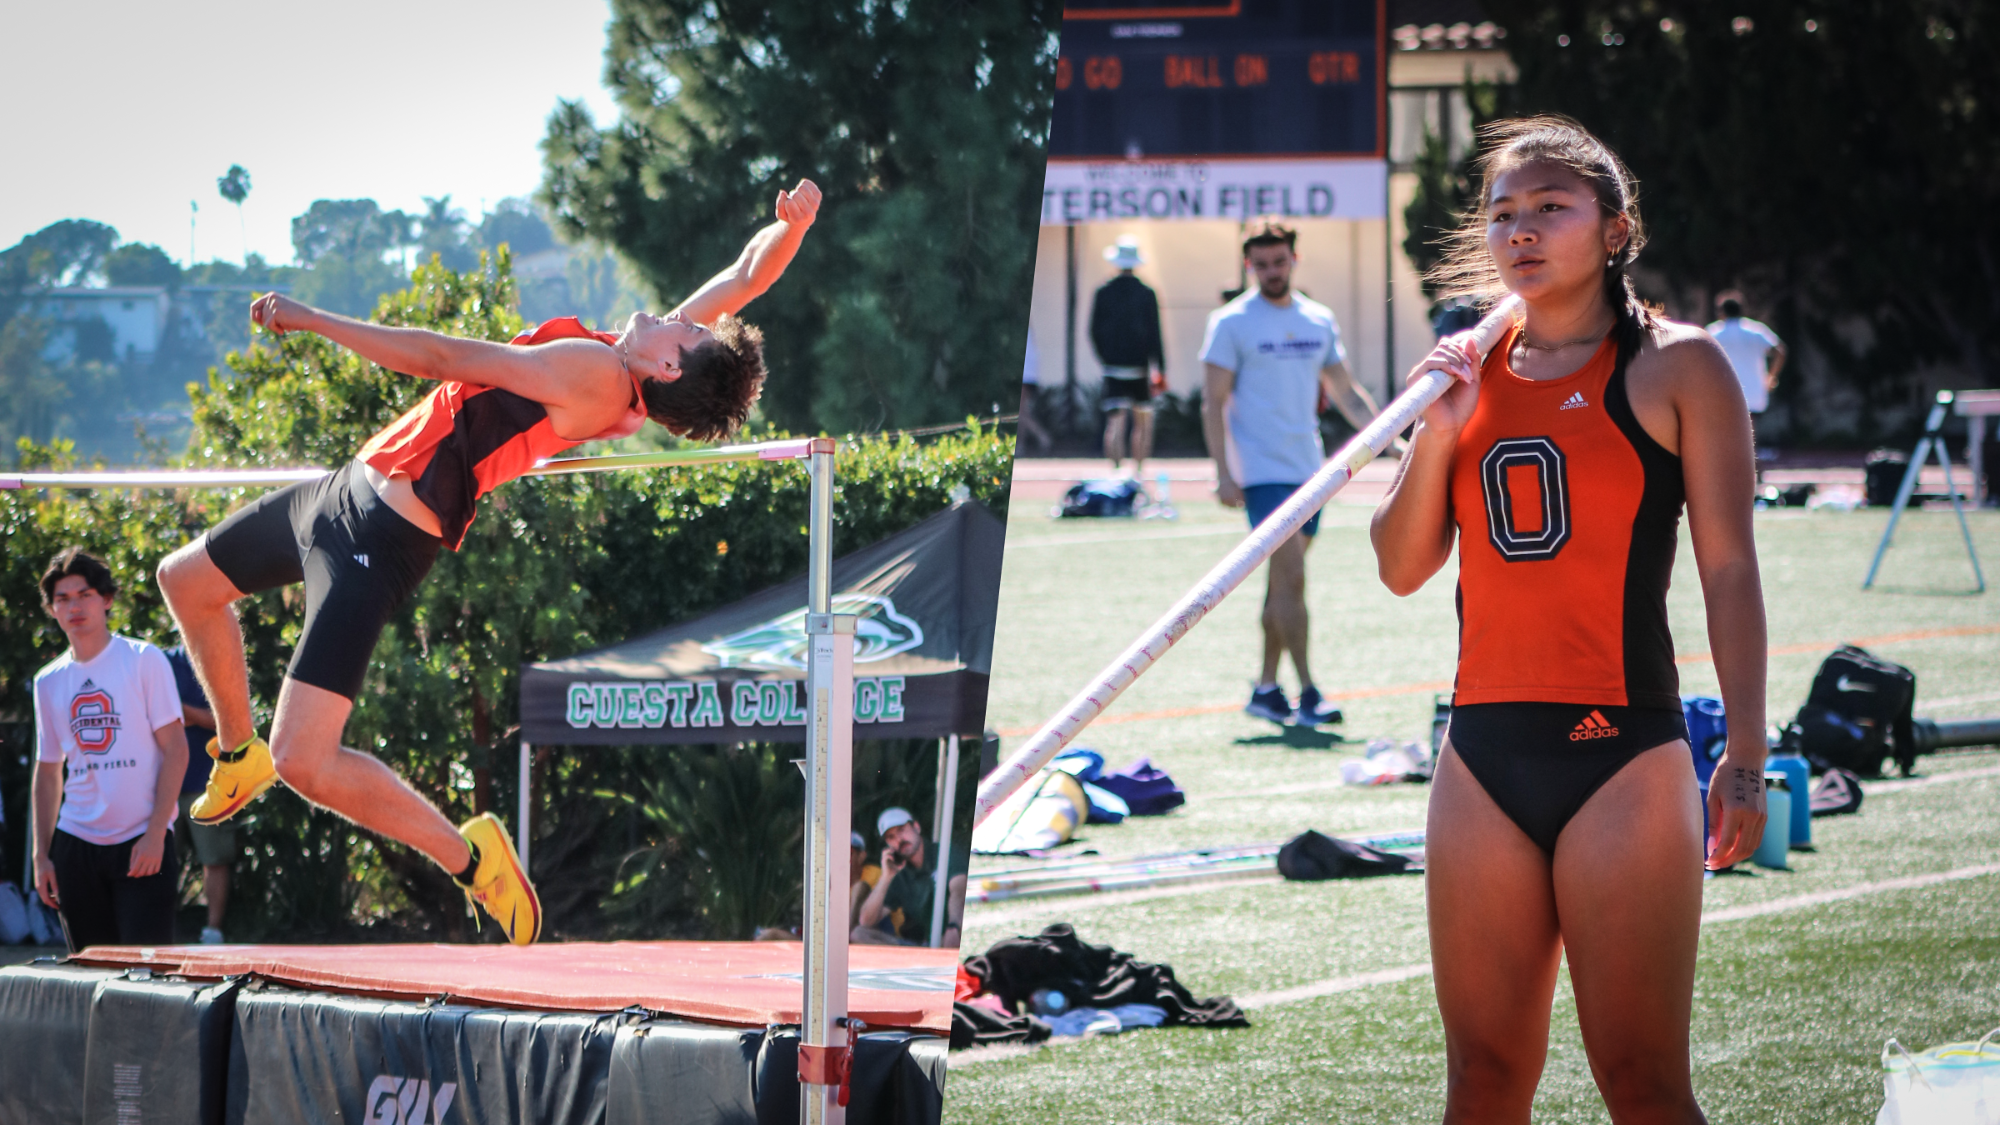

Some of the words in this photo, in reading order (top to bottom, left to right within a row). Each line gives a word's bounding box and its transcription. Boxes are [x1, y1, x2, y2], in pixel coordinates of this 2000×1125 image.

[1084, 55, 1123, 90] GO
[1164, 54, 1224, 88] BALL
[1234, 53, 1268, 87] ON
[1309, 51, 1361, 85] QTR
[1218, 183, 1335, 217] FIELD
[1560, 401, 1588, 411] adidas
[566, 682, 724, 728] CUESTA
[731, 676, 905, 726] COLGE
[1569, 727, 1619, 741] adidas
[104, 759, 136, 770] FIELD
